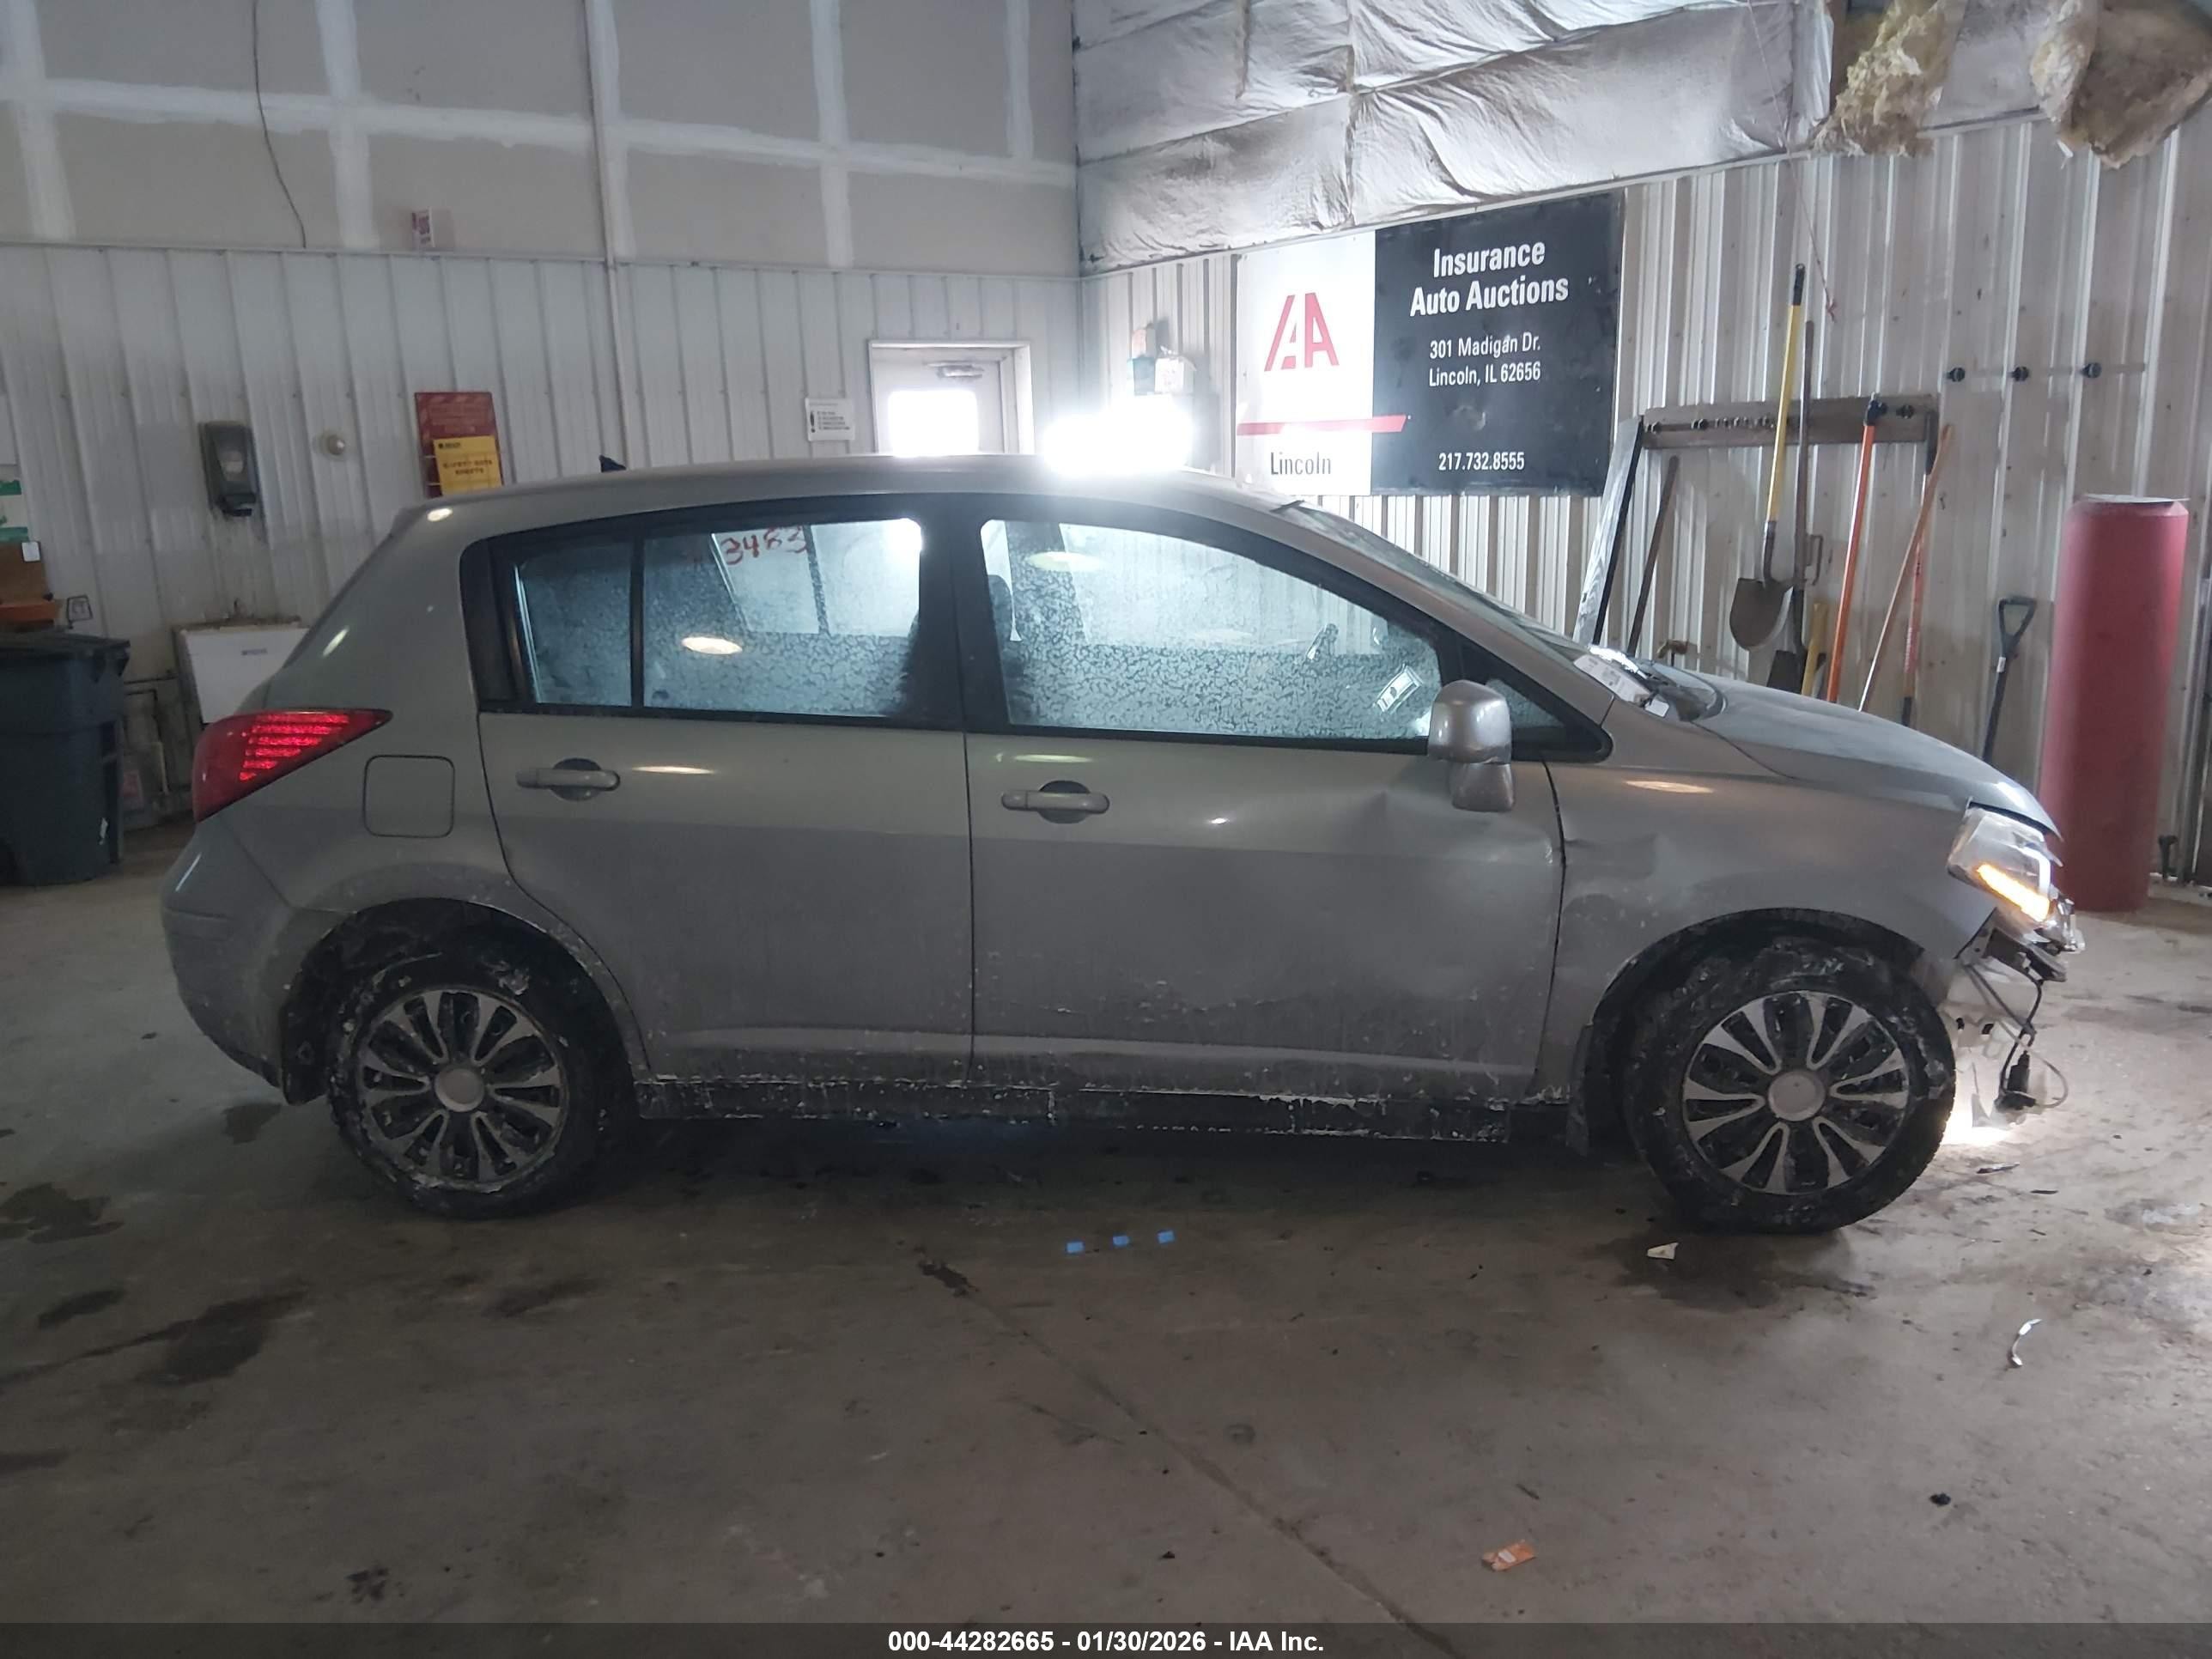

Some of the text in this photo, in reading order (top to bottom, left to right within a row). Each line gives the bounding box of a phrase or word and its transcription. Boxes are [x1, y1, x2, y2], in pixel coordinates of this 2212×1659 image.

[1433, 241, 1546, 278] Insurance
[1409, 275, 1569, 318] Auto Auctions
[1429, 331, 1540, 360] 301 Madigan Dr.
[1429, 361, 1541, 387] Lincoln, IL 62656
[1270, 451, 1331, 475] Lincoln
[1438, 451, 1525, 471] 217.732.8555
